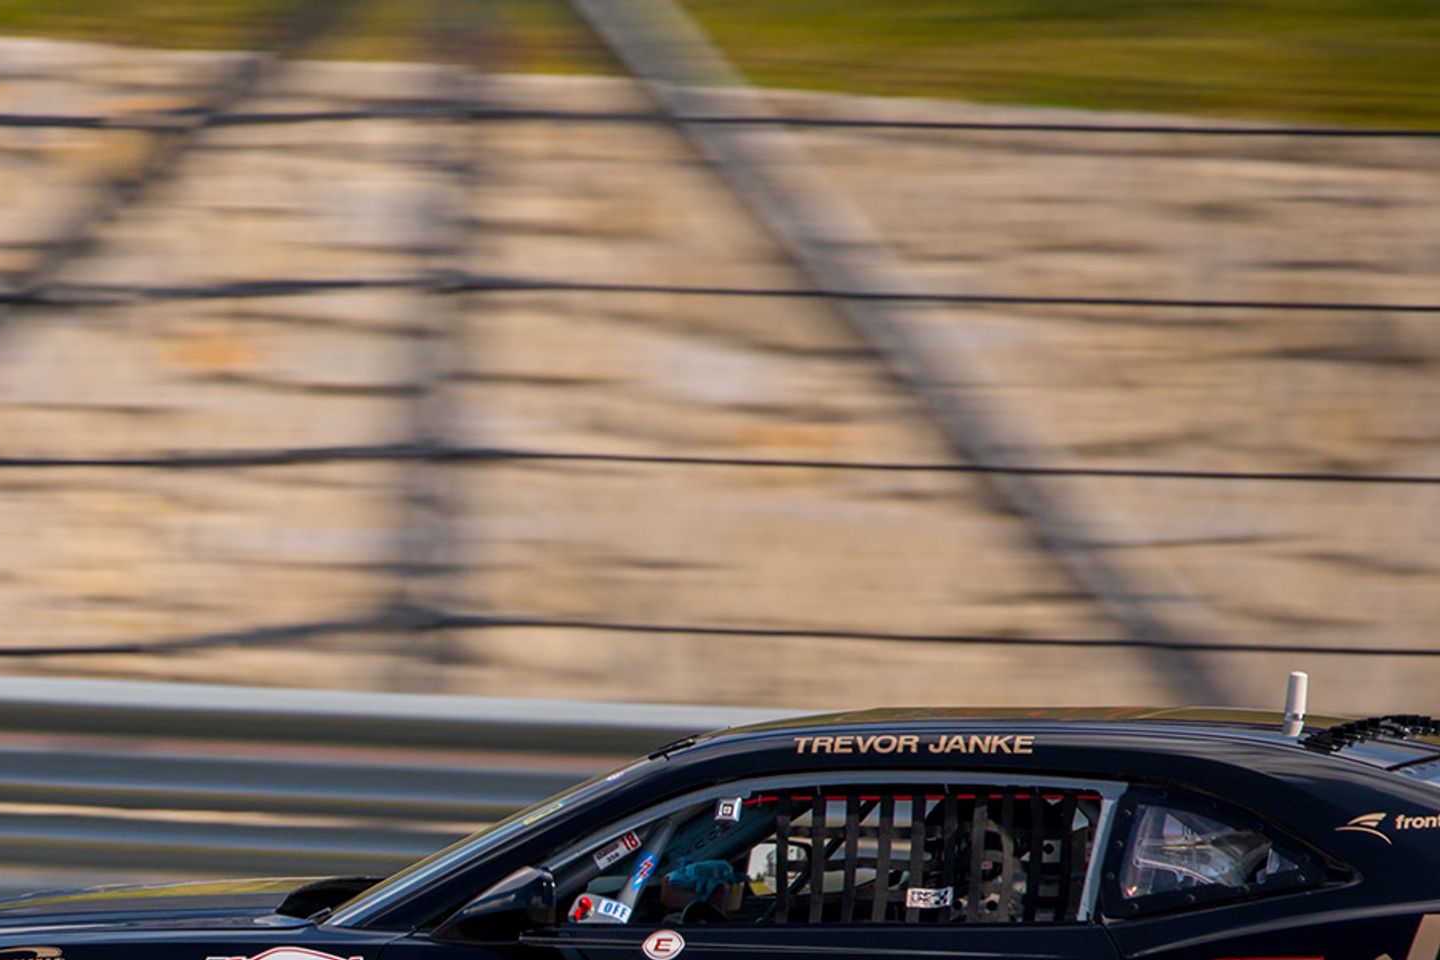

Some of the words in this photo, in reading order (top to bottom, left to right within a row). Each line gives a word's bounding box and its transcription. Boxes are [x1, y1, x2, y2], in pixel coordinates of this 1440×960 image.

[794, 735, 920, 754] TREVOR
[928, 735, 1035, 754] JANKE
[603, 901, 628, 918] OFF
[654, 938, 673, 952] E
